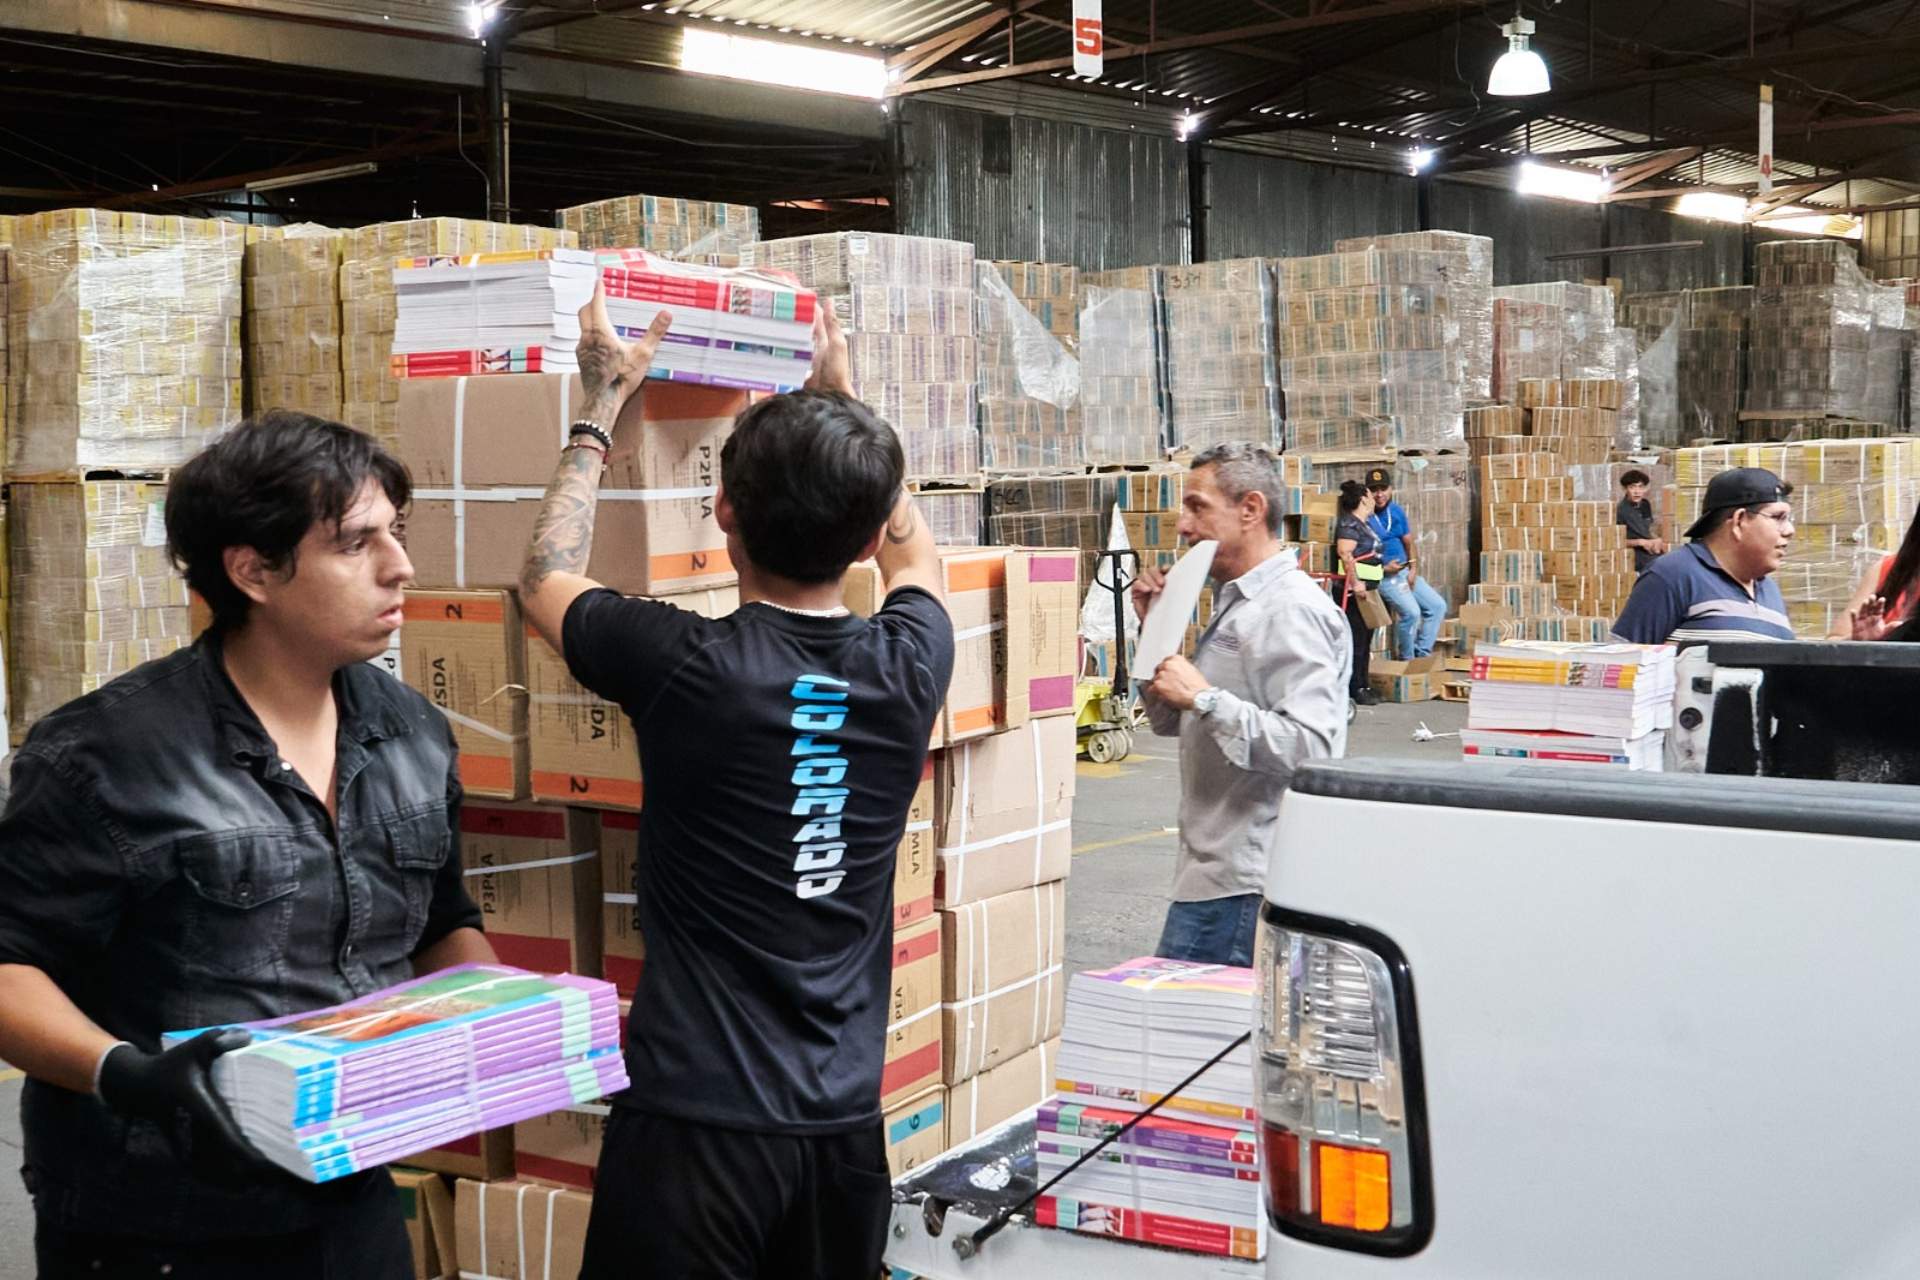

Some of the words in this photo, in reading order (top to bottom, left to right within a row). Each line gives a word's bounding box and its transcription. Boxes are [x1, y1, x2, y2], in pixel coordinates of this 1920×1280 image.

[1075, 18, 1102, 56] 5
[1760, 153, 1773, 178] 4
[698, 445, 713, 519] P2PA
[691, 553, 707, 571] 2
[446, 603, 463, 619] 2
[570, 776, 589, 794] 2
[790, 673, 850, 900] COLORADO
[911, 807, 921, 875] PMLA
[900, 904, 911, 919] 3
[894, 985, 904, 1043] PPEA
